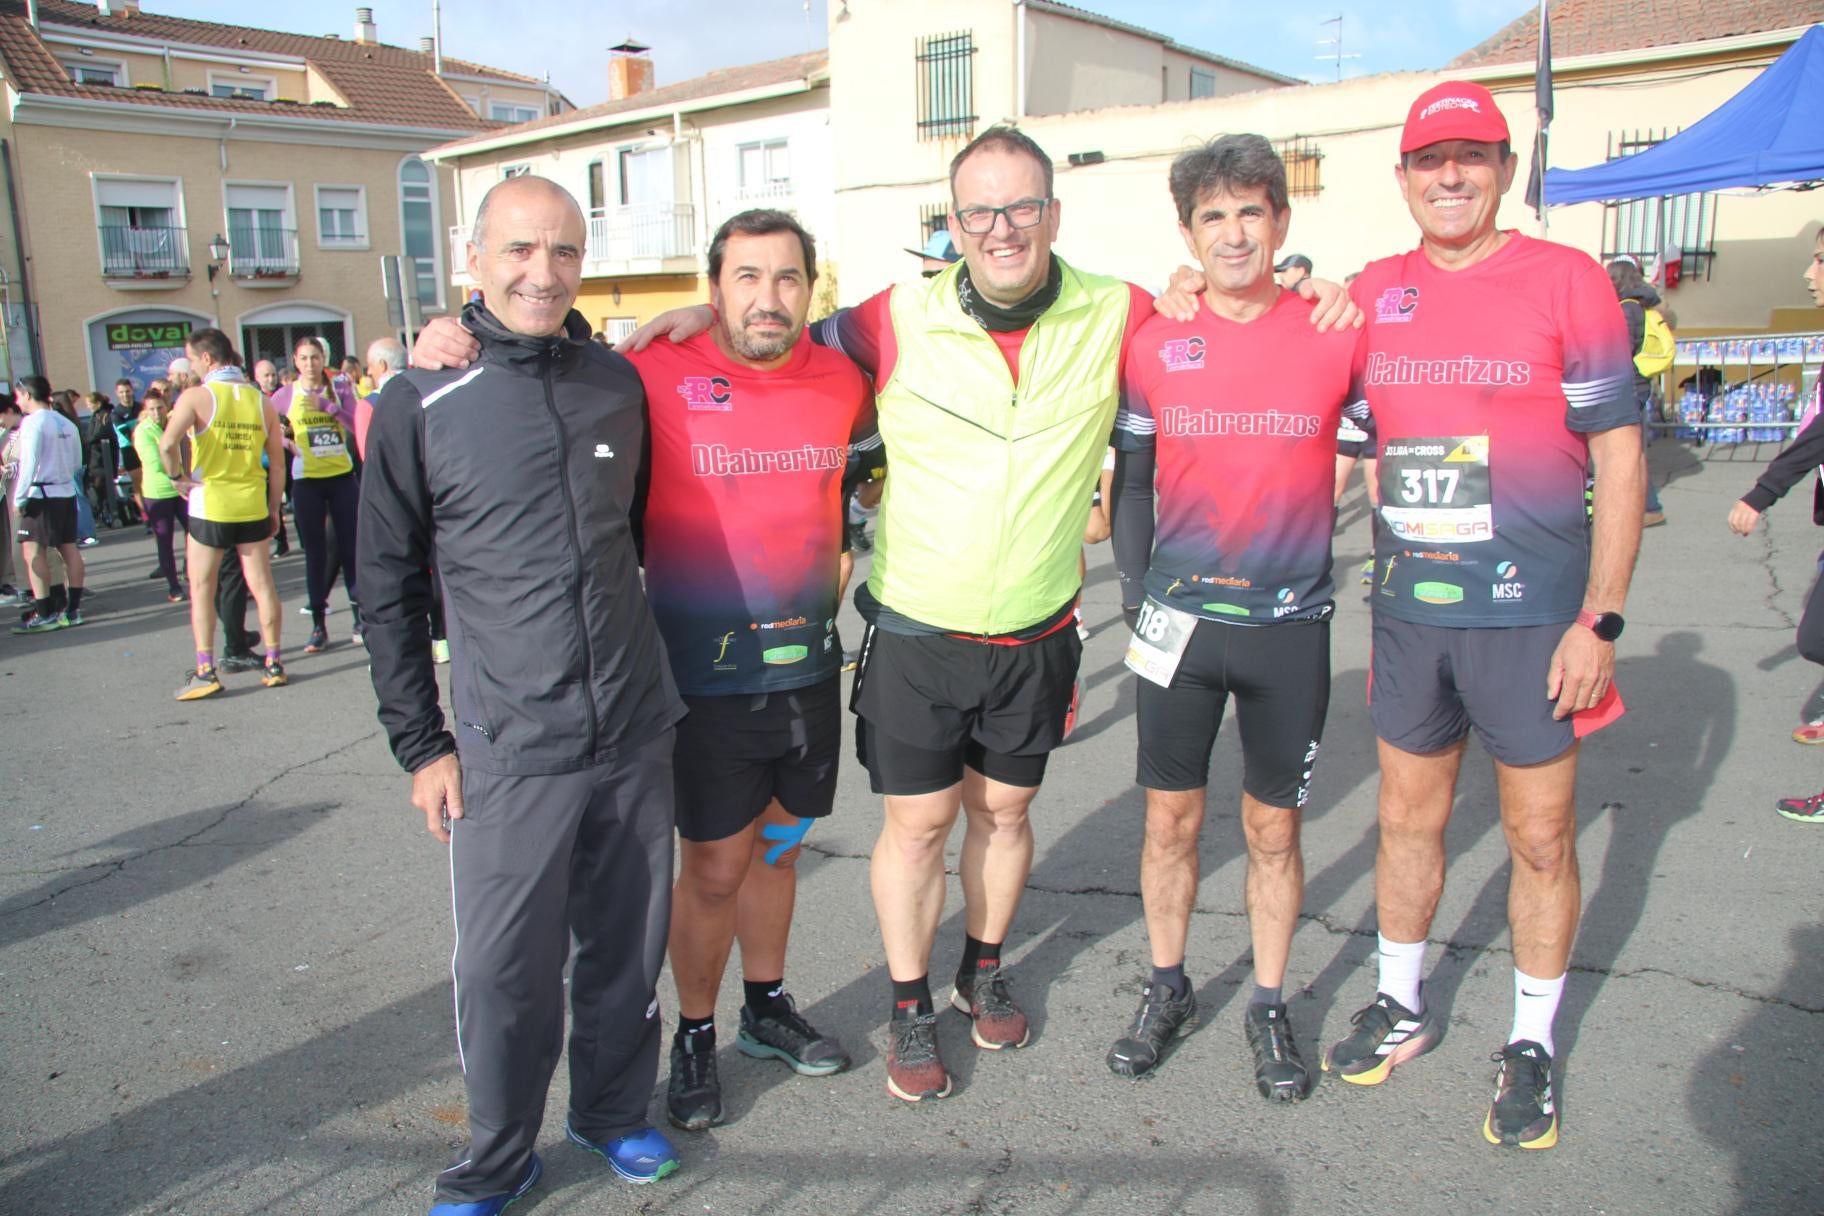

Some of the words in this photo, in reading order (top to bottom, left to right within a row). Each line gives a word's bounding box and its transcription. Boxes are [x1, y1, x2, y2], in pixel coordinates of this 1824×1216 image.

[111, 321, 190, 342] doval
[1161, 405, 1321, 437] DCabrerizos
[313, 433, 340, 446] 424
[691, 444, 845, 477] DCabrerizos
[1415, 445, 1445, 456] CROSS
[1401, 469, 1460, 504] 317
[1492, 582, 1522, 599] MSC
